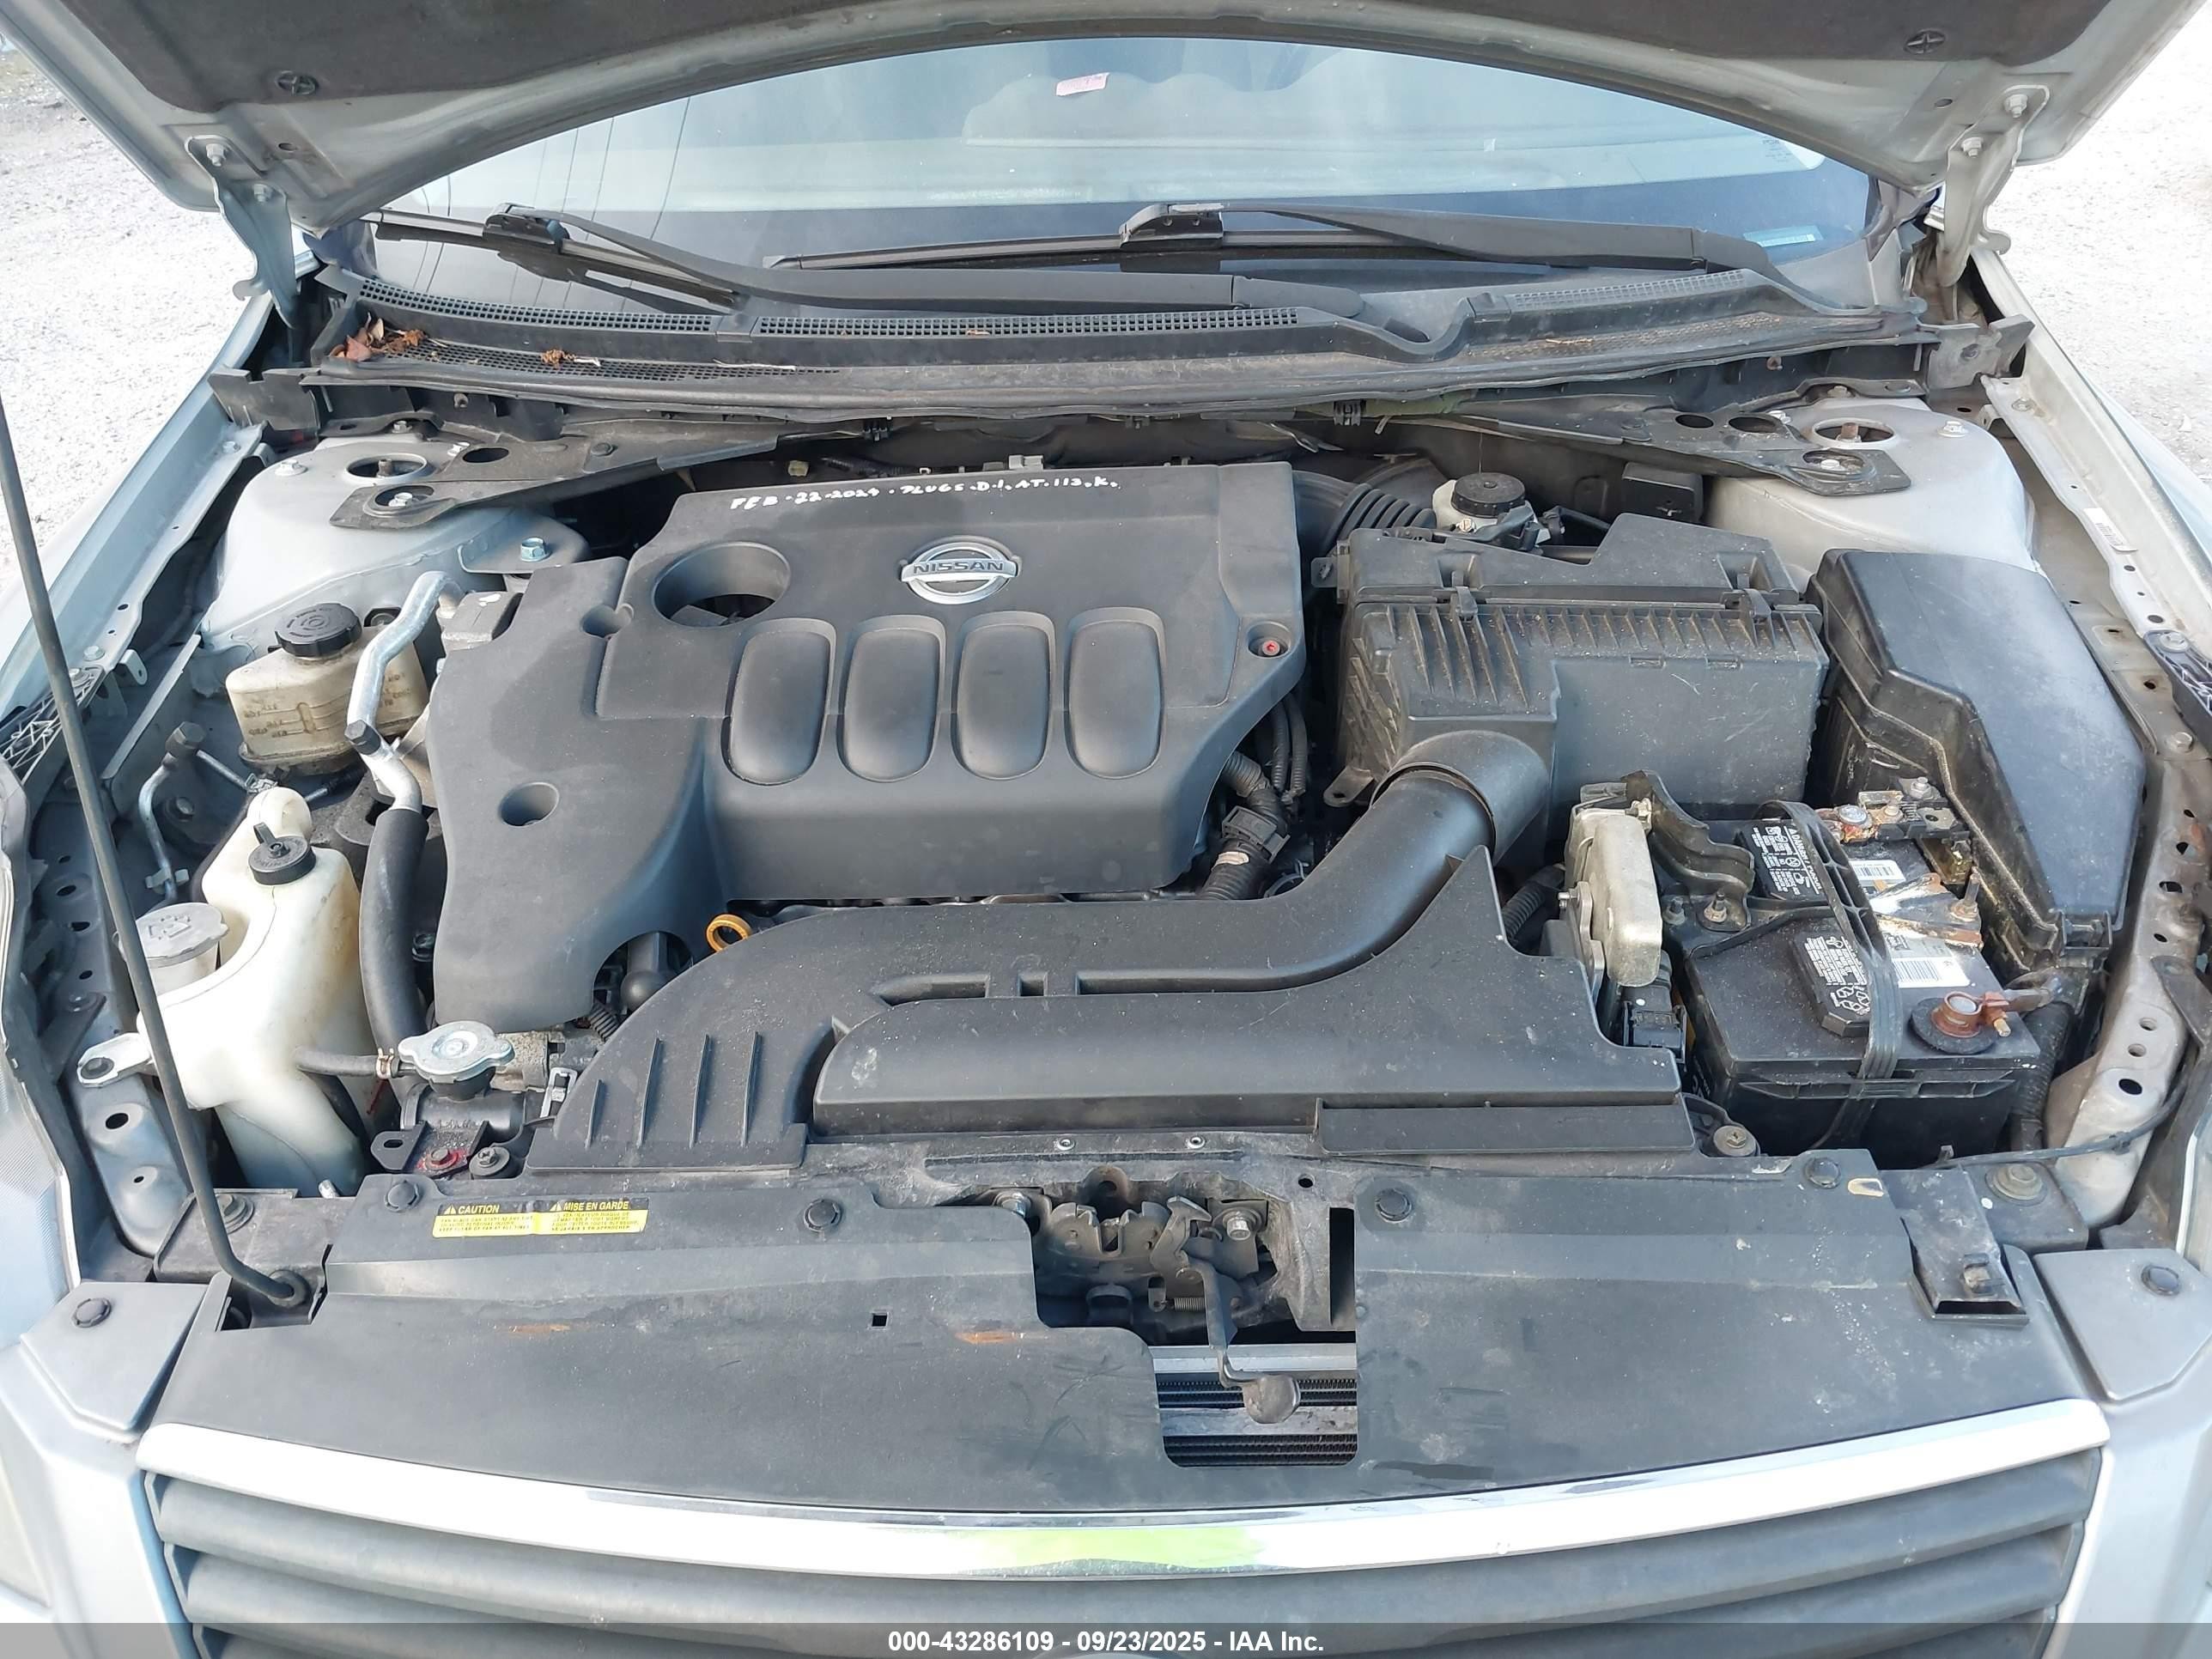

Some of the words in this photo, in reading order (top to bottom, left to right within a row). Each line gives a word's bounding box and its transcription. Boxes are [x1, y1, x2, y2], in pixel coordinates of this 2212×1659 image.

[913, 562, 1004, 574] NISSAN
[458, 1204, 500, 1214] CAUTION
[563, 1201, 585, 1212] MISE
[586, 1201, 599, 1211] EN
[599, 1200, 630, 1210] GARDE
